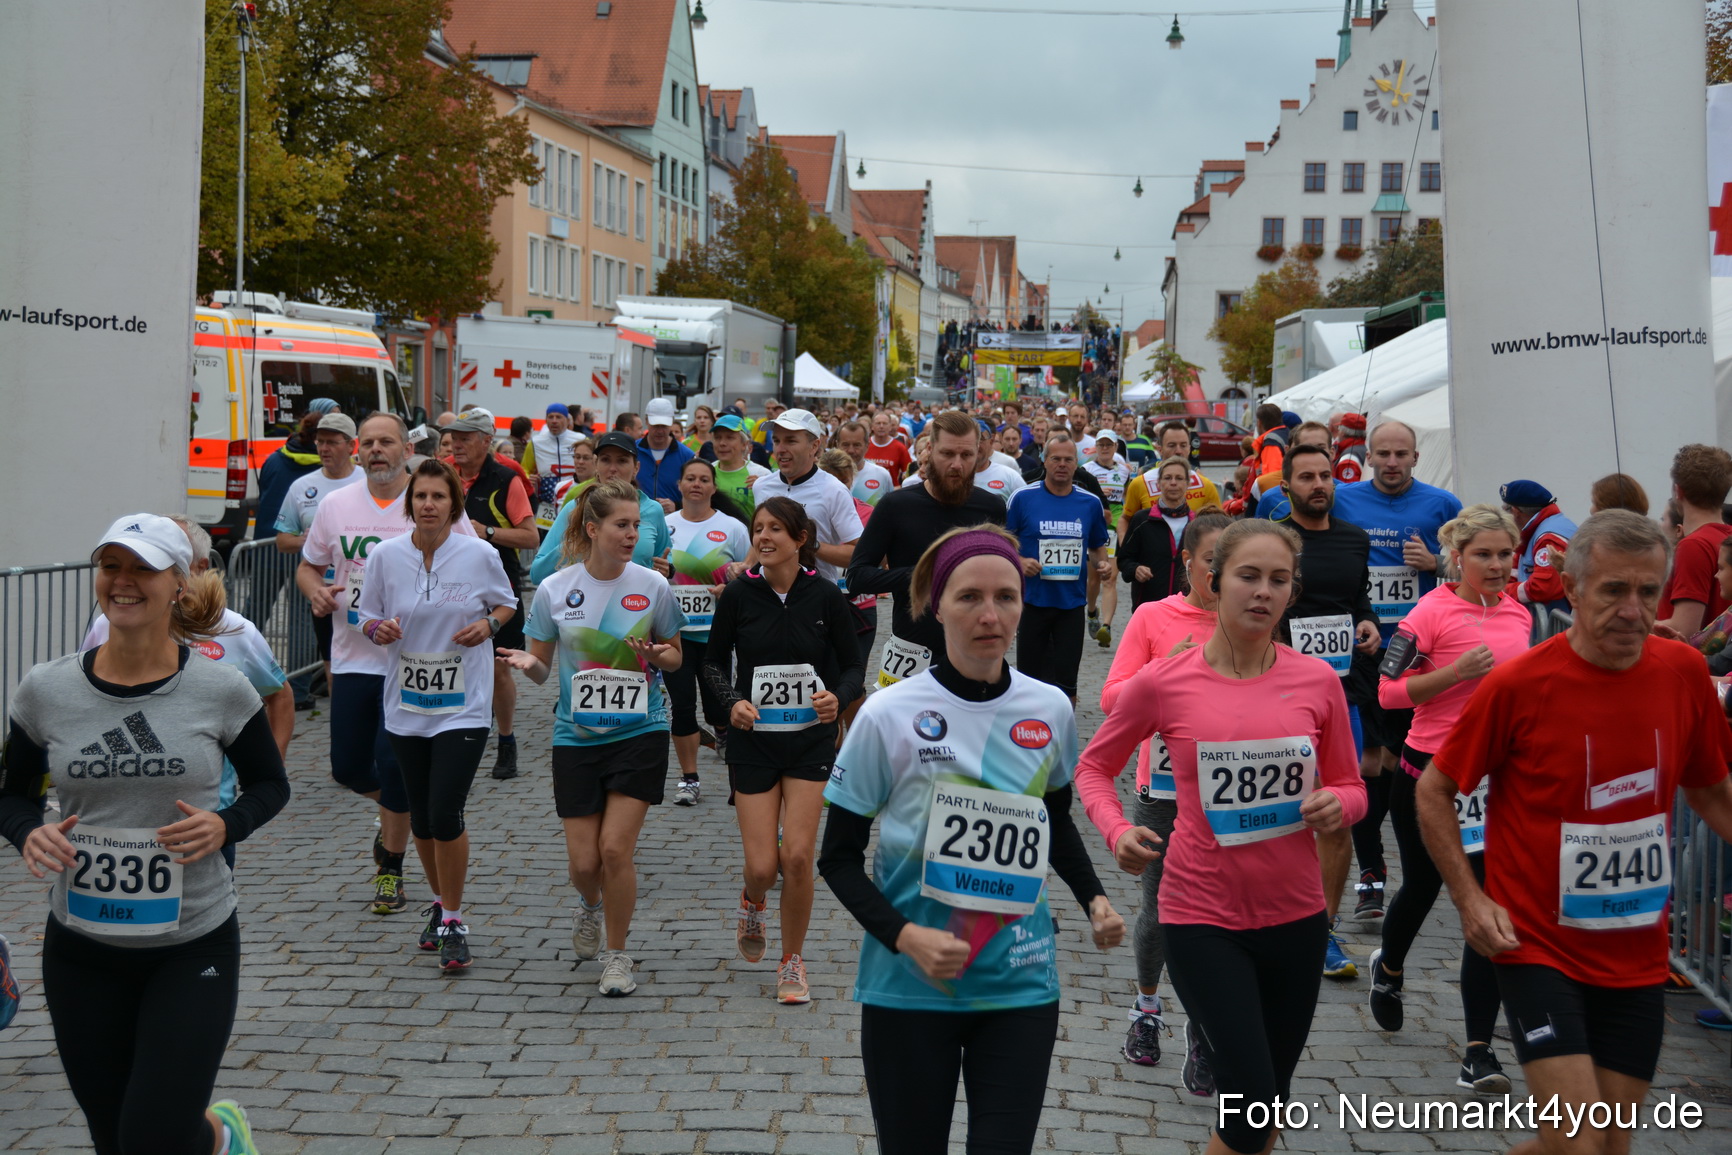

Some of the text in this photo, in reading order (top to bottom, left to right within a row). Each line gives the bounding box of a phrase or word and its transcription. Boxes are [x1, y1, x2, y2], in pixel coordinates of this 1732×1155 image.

[1491, 326, 1707, 355] www.bmw-laufsport.de
[1009, 353, 1045, 363] START
[526, 360, 577, 372] Bayerisches
[526, 371, 550, 380] Rotes
[525, 382, 549, 391] Kreuz
[1184, 490, 1206, 500] ÖGL
[1040, 521, 1083, 532] HUBER
[1044, 549, 1080, 564] 2175
[1050, 567, 1075, 575] Christian
[1365, 580, 1414, 601] 2145
[625, 598, 647, 608] Hervis
[1374, 606, 1399, 615] Benni
[1315, 621, 1344, 629] Neumarkt
[1300, 630, 1350, 655] 2380
[419, 657, 452, 666] Neumarkt
[403, 666, 458, 691] 2647
[573, 674, 635, 682] PARTL Neumarkt
[755, 670, 813, 679] PARTL Neumarkt
[579, 684, 641, 710] 2147
[760, 679, 818, 706] 2311
[418, 695, 443, 707] Silvia
[597, 716, 621, 726] Julia
[783, 711, 798, 722] Evi
[1016, 727, 1049, 741] Hervis
[918, 746, 956, 757] PARTL
[1200, 748, 1296, 761] PARTL Neumarkt
[67, 753, 186, 779] adidas
[920, 754, 957, 765] Neumarkt
[1211, 761, 1304, 805] 2828
[1608, 780, 1638, 797] DEHN
[936, 793, 1035, 820] PARTL Neumarkt
[1239, 812, 1277, 829] Elena
[71, 833, 162, 849] ARTL Neumarkt
[939, 814, 1041, 869] 2308
[1565, 830, 1655, 845] PARTL Neumarkt
[73, 849, 172, 894] 2336
[1575, 843, 1663, 889] 2440
[954, 871, 1015, 897] Wencke
[99, 903, 135, 920] Alex
[1602, 898, 1640, 914] Franz
